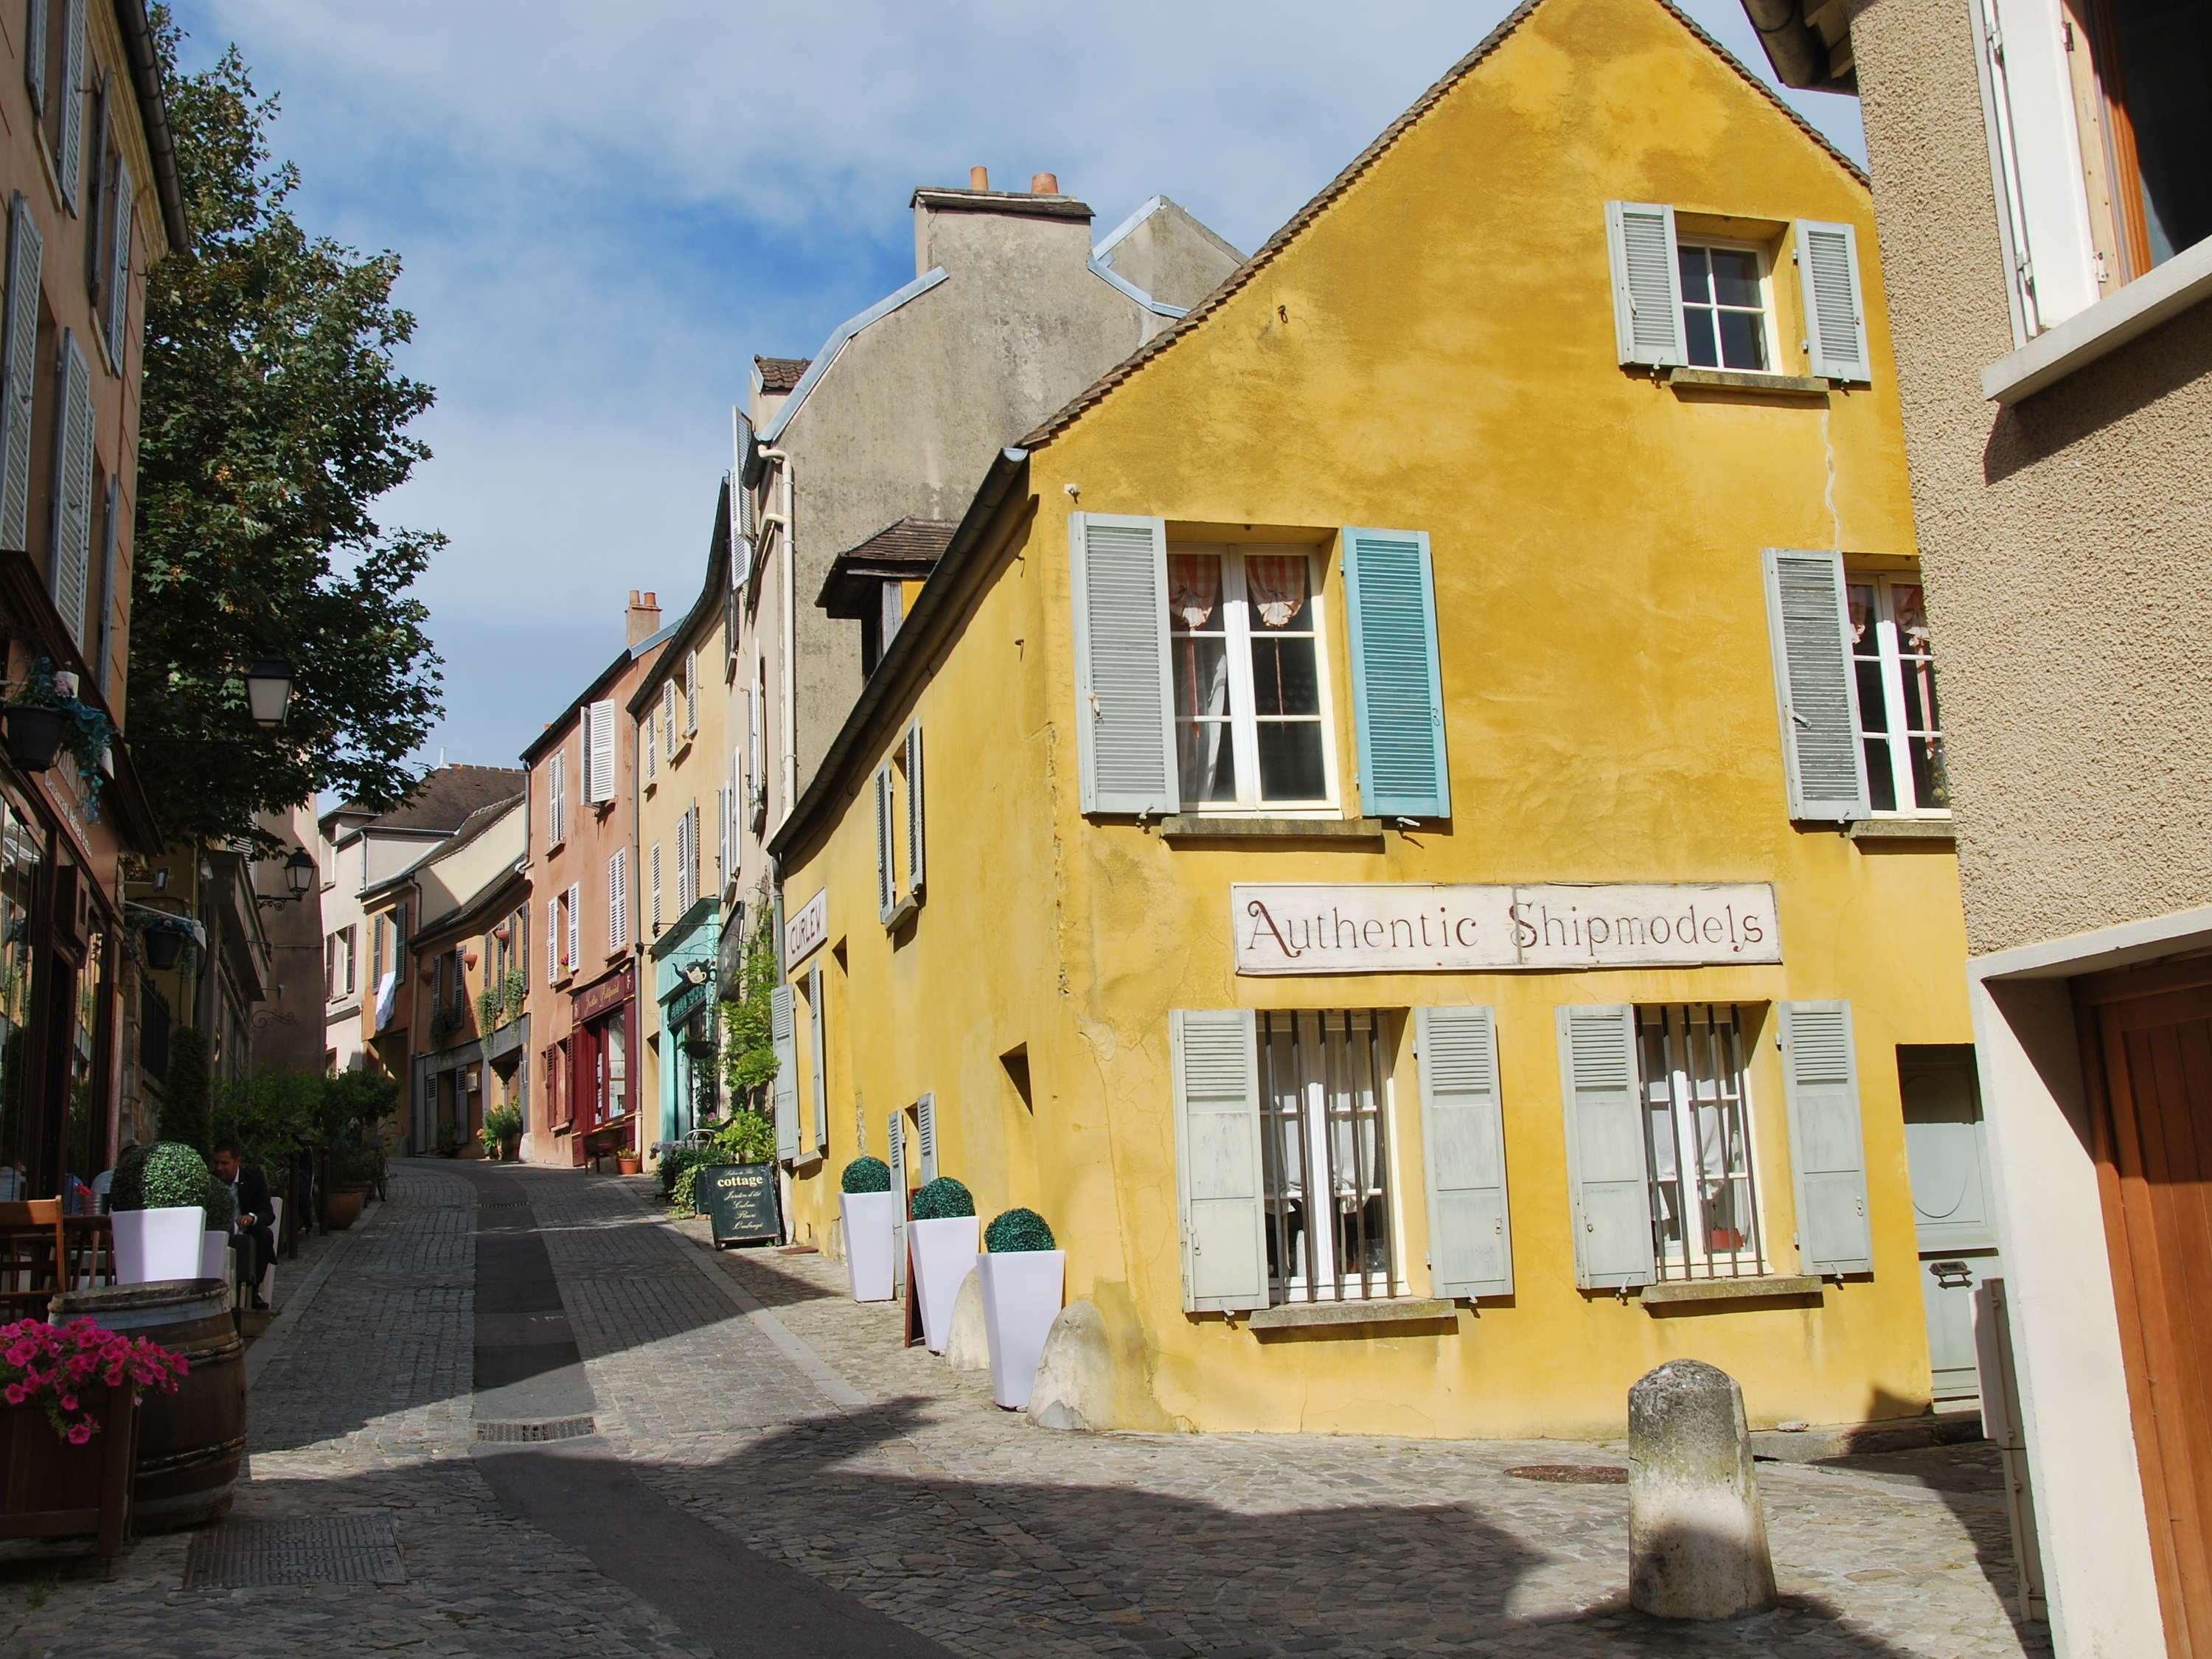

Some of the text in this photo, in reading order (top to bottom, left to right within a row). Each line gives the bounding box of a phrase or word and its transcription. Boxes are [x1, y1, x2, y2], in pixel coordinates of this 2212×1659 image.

[1246, 899, 1764, 959] Authentic Shipmodels
[717, 1176, 763, 1187] cottage
